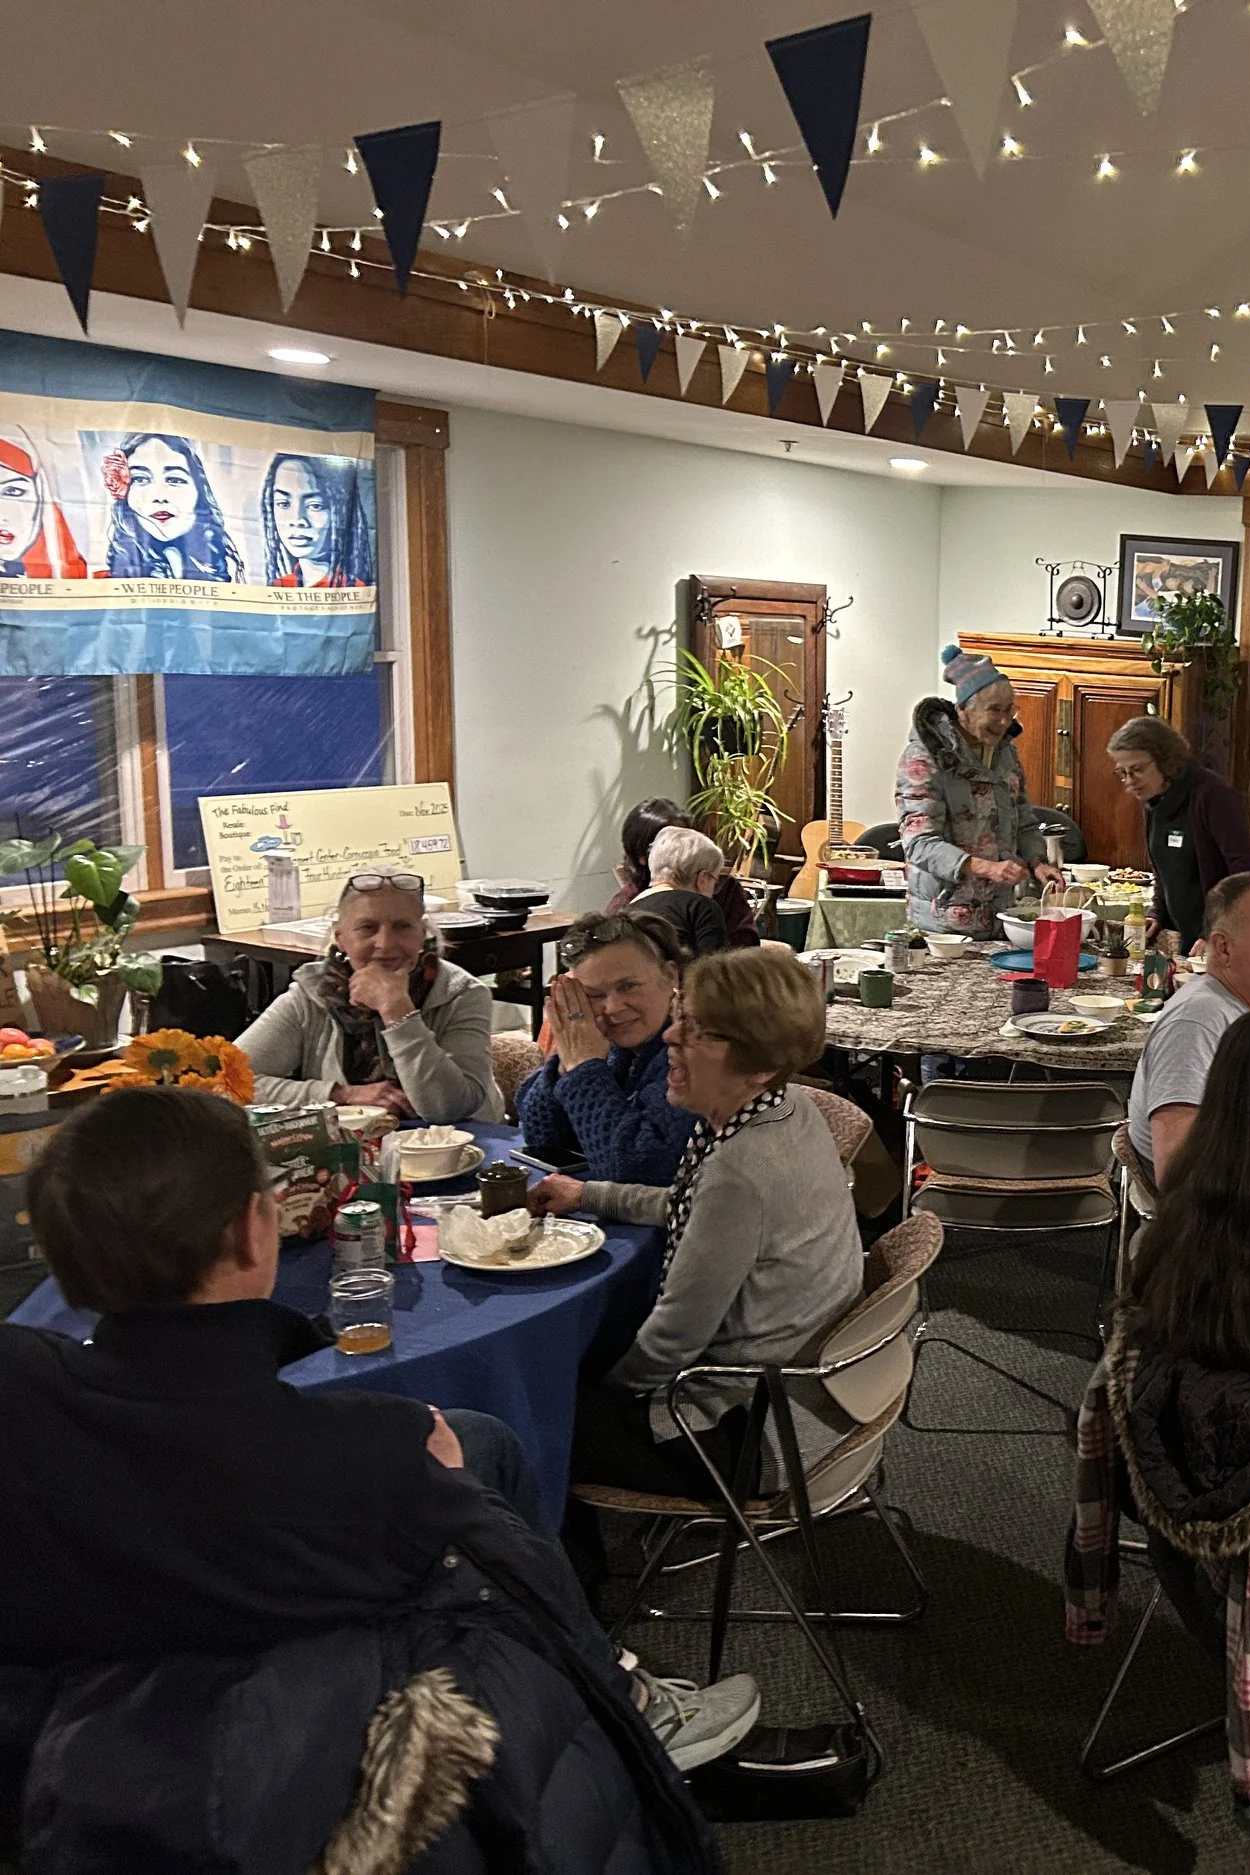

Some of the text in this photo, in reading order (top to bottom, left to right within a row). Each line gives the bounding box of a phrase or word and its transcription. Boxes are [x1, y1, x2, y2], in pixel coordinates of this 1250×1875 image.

[0, 583, 54, 595] PEOPLE
[149, 583, 168, 594] THE
[169, 584, 219, 596] PEOPLE
[295, 592, 321, 602] THE
[324, 592, 360, 602] PEOPLE
[212, 801, 289, 818] The Fabulous Find
